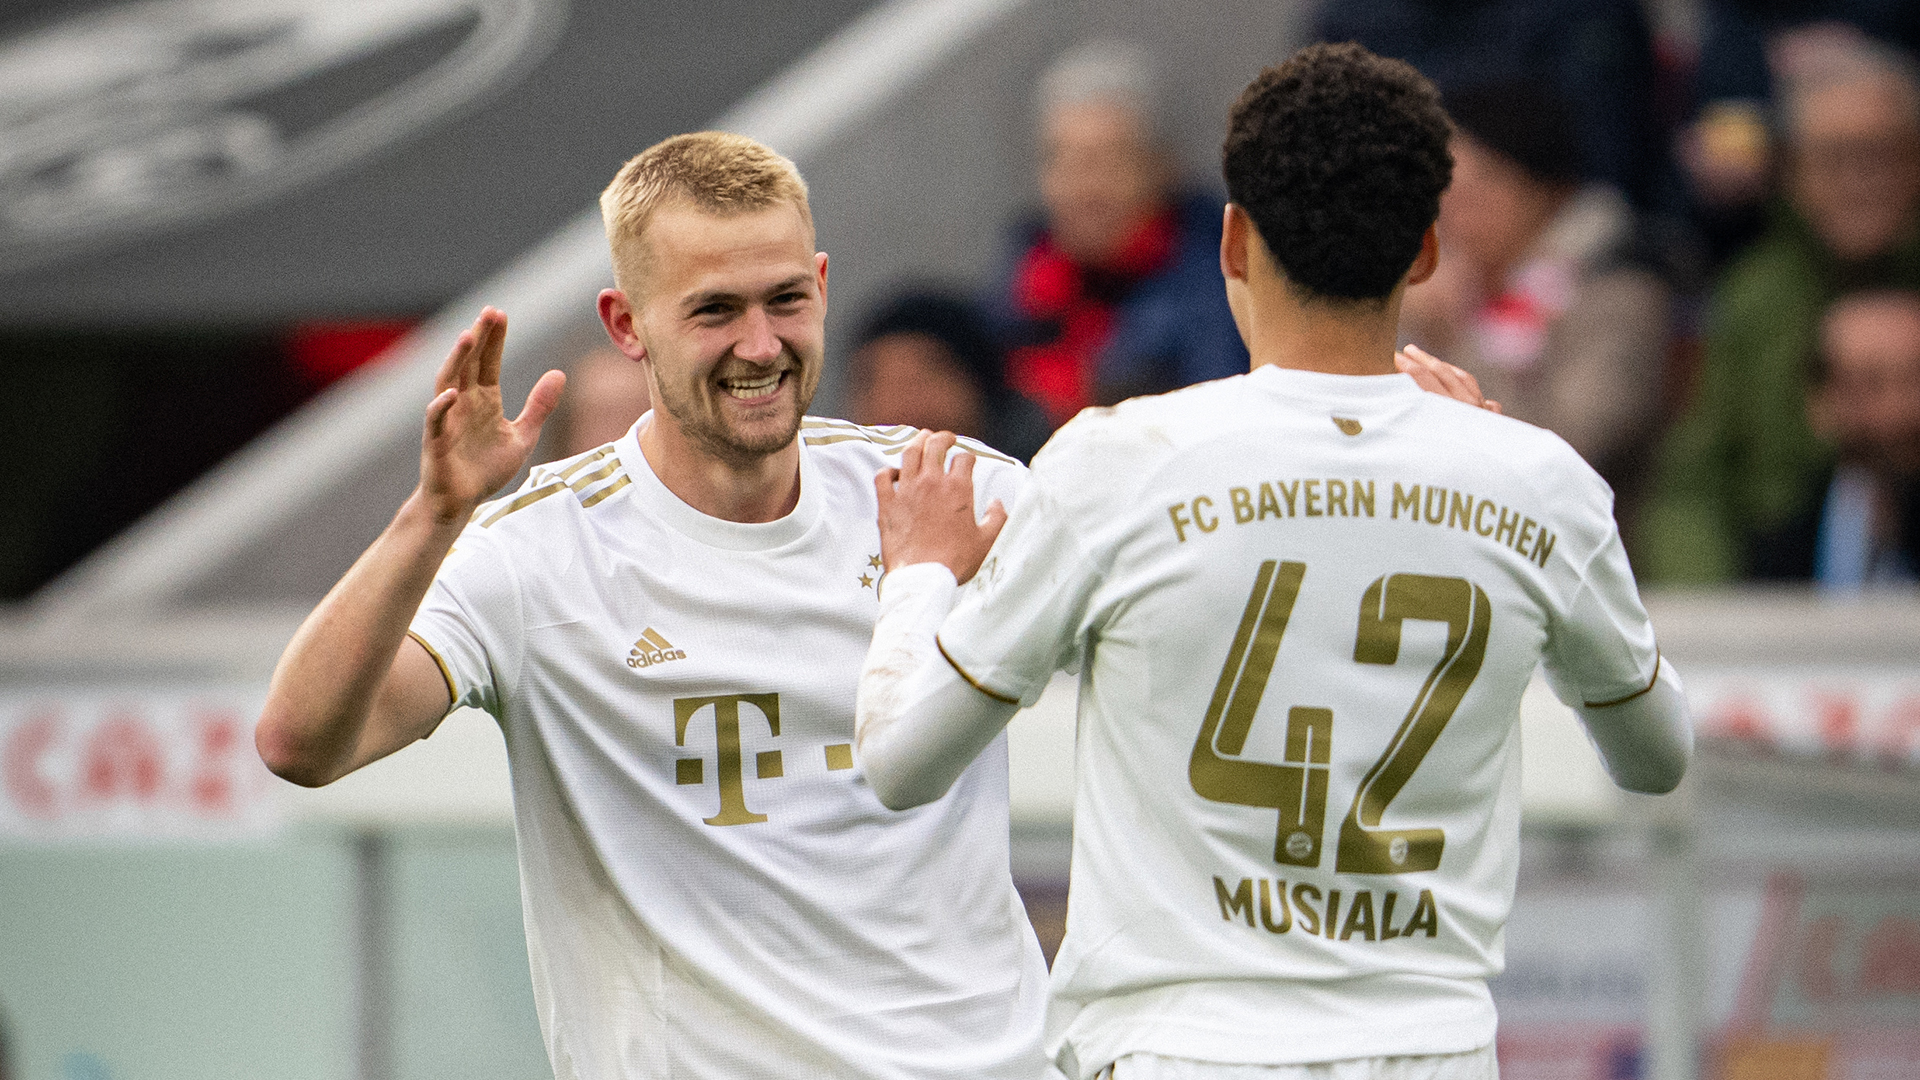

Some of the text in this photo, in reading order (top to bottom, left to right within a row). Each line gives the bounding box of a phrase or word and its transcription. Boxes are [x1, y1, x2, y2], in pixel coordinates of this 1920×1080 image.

[1168, 478, 1556, 568] FC BAYERN MÜNCHEN
[626, 649, 687, 669] adidas
[1188, 559, 1491, 875] 42
[1212, 876, 1438, 942] MUSIALA
